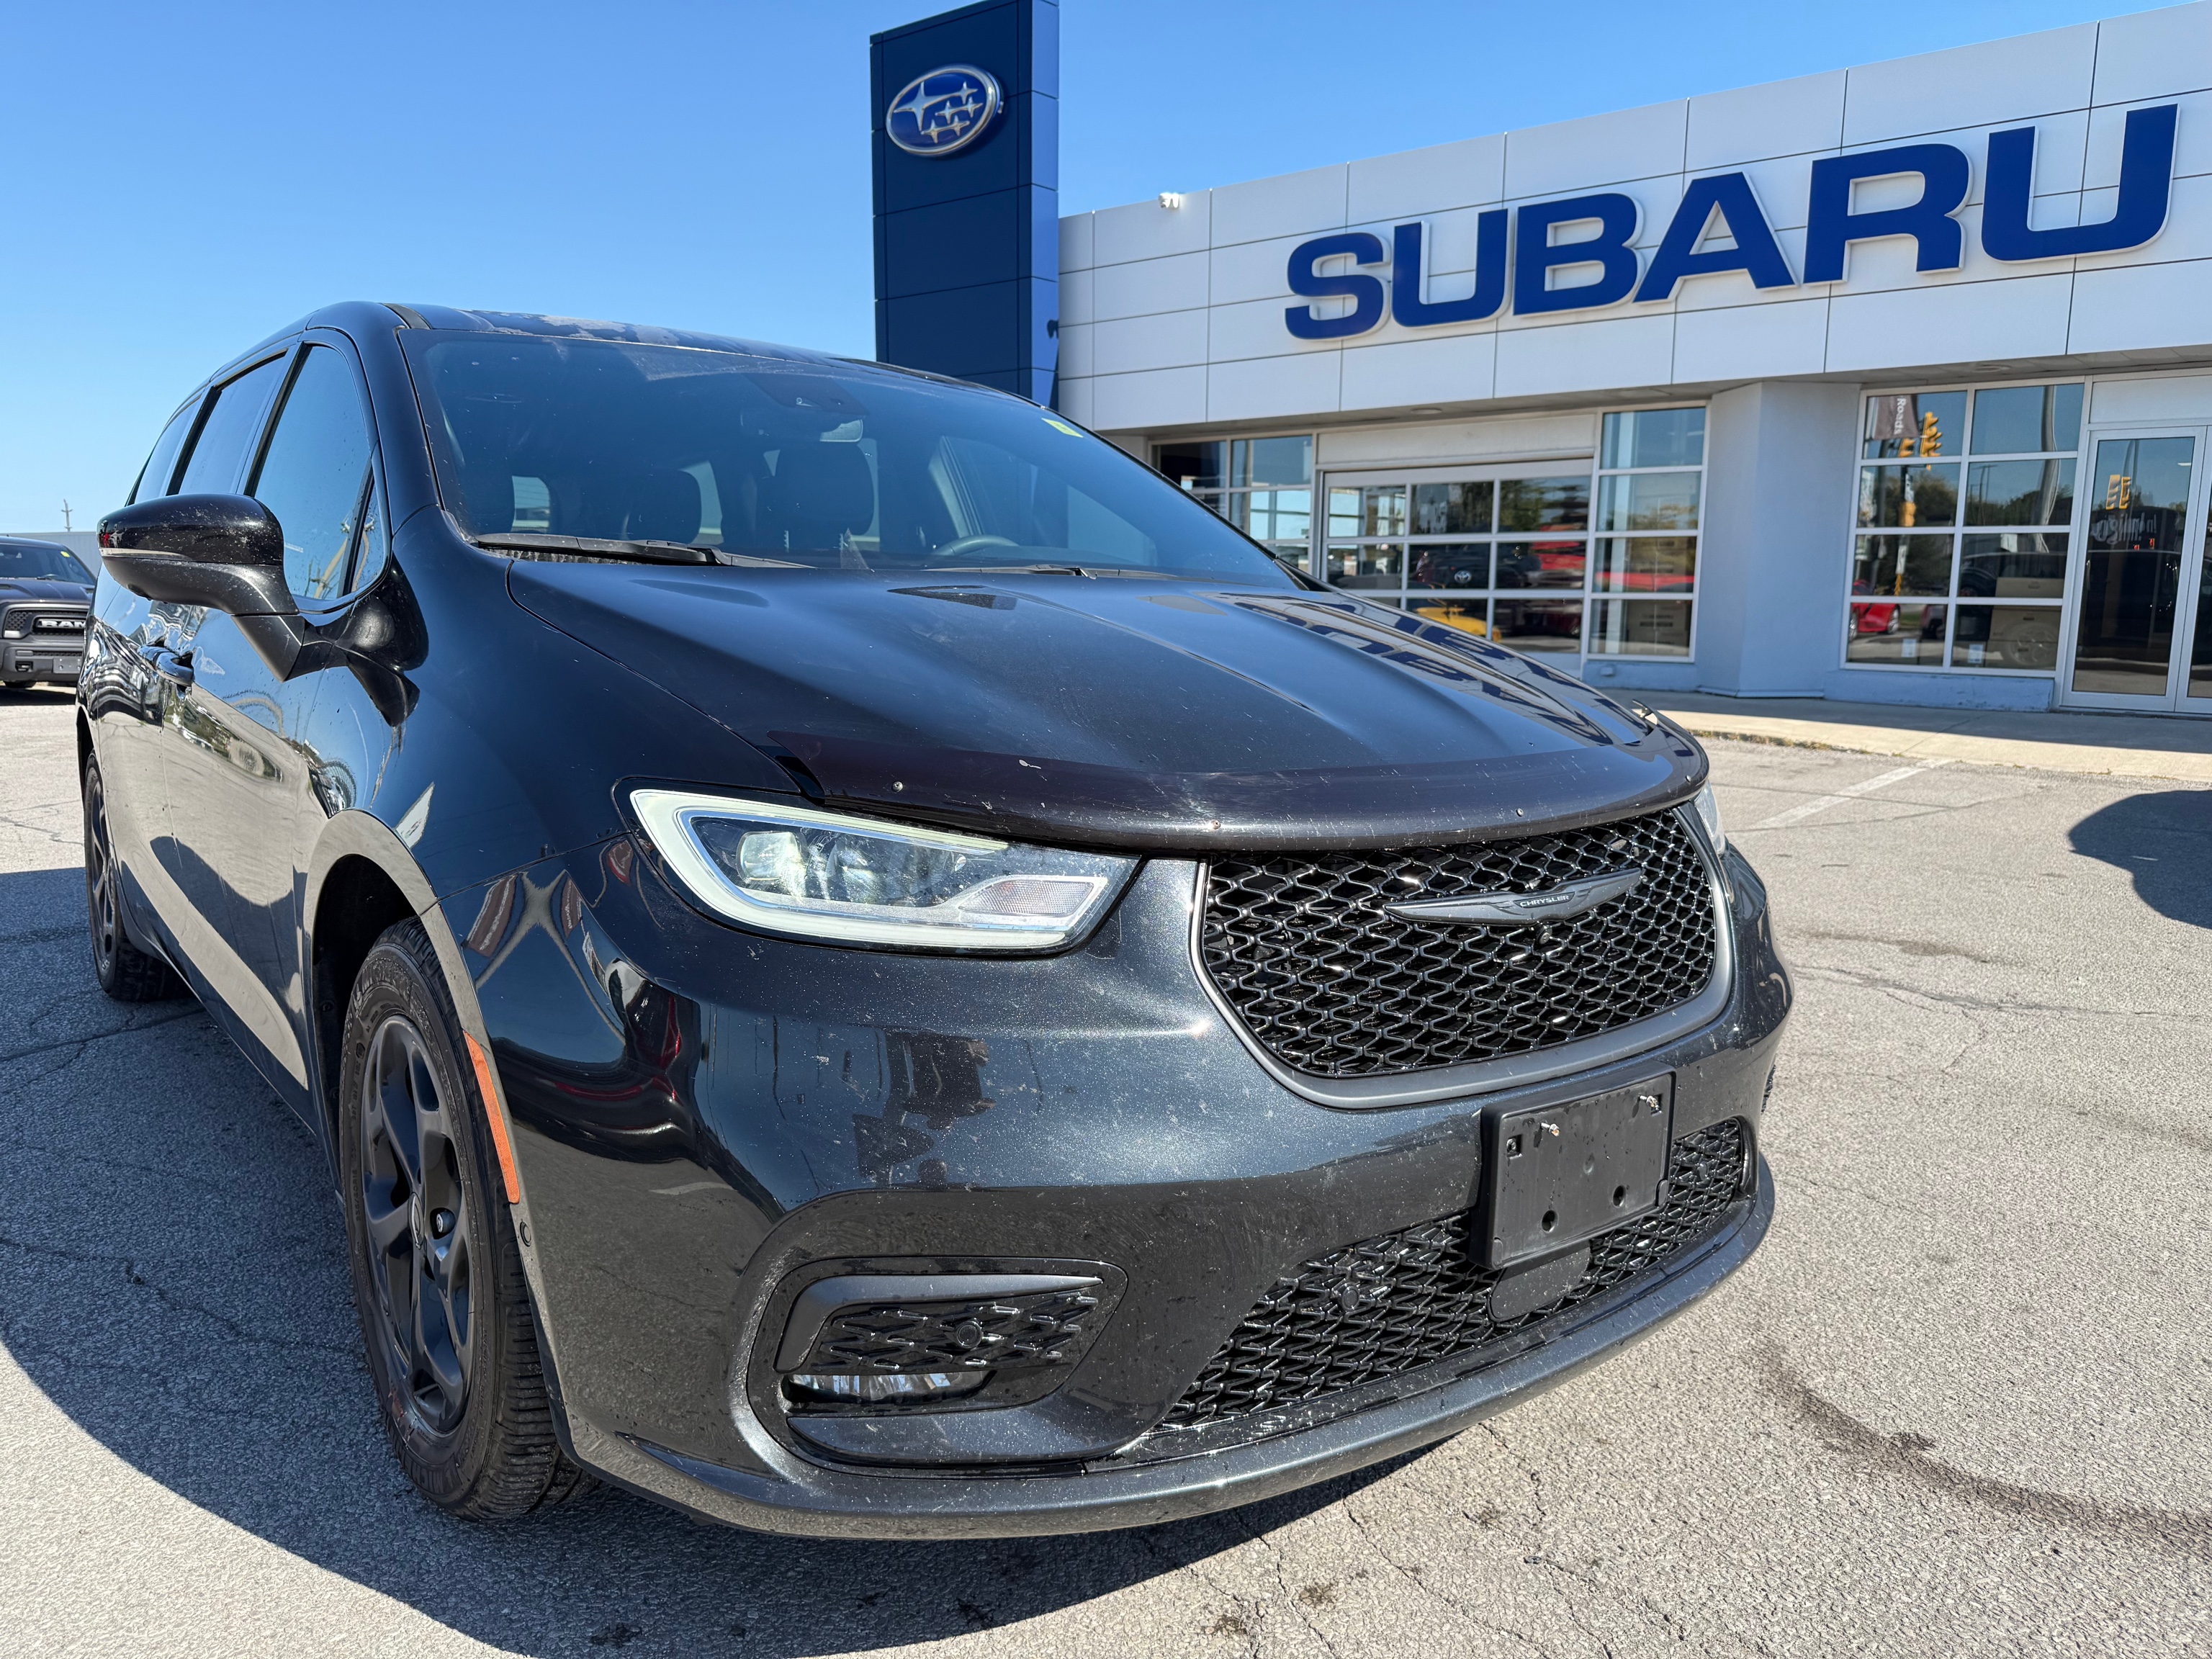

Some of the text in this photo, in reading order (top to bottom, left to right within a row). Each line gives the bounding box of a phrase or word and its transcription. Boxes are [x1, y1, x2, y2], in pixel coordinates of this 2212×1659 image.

[1285, 103, 2179, 340] SUBARU
[38, 620, 86, 629] RAM
[1519, 895, 1570, 907] CHRYSLER
